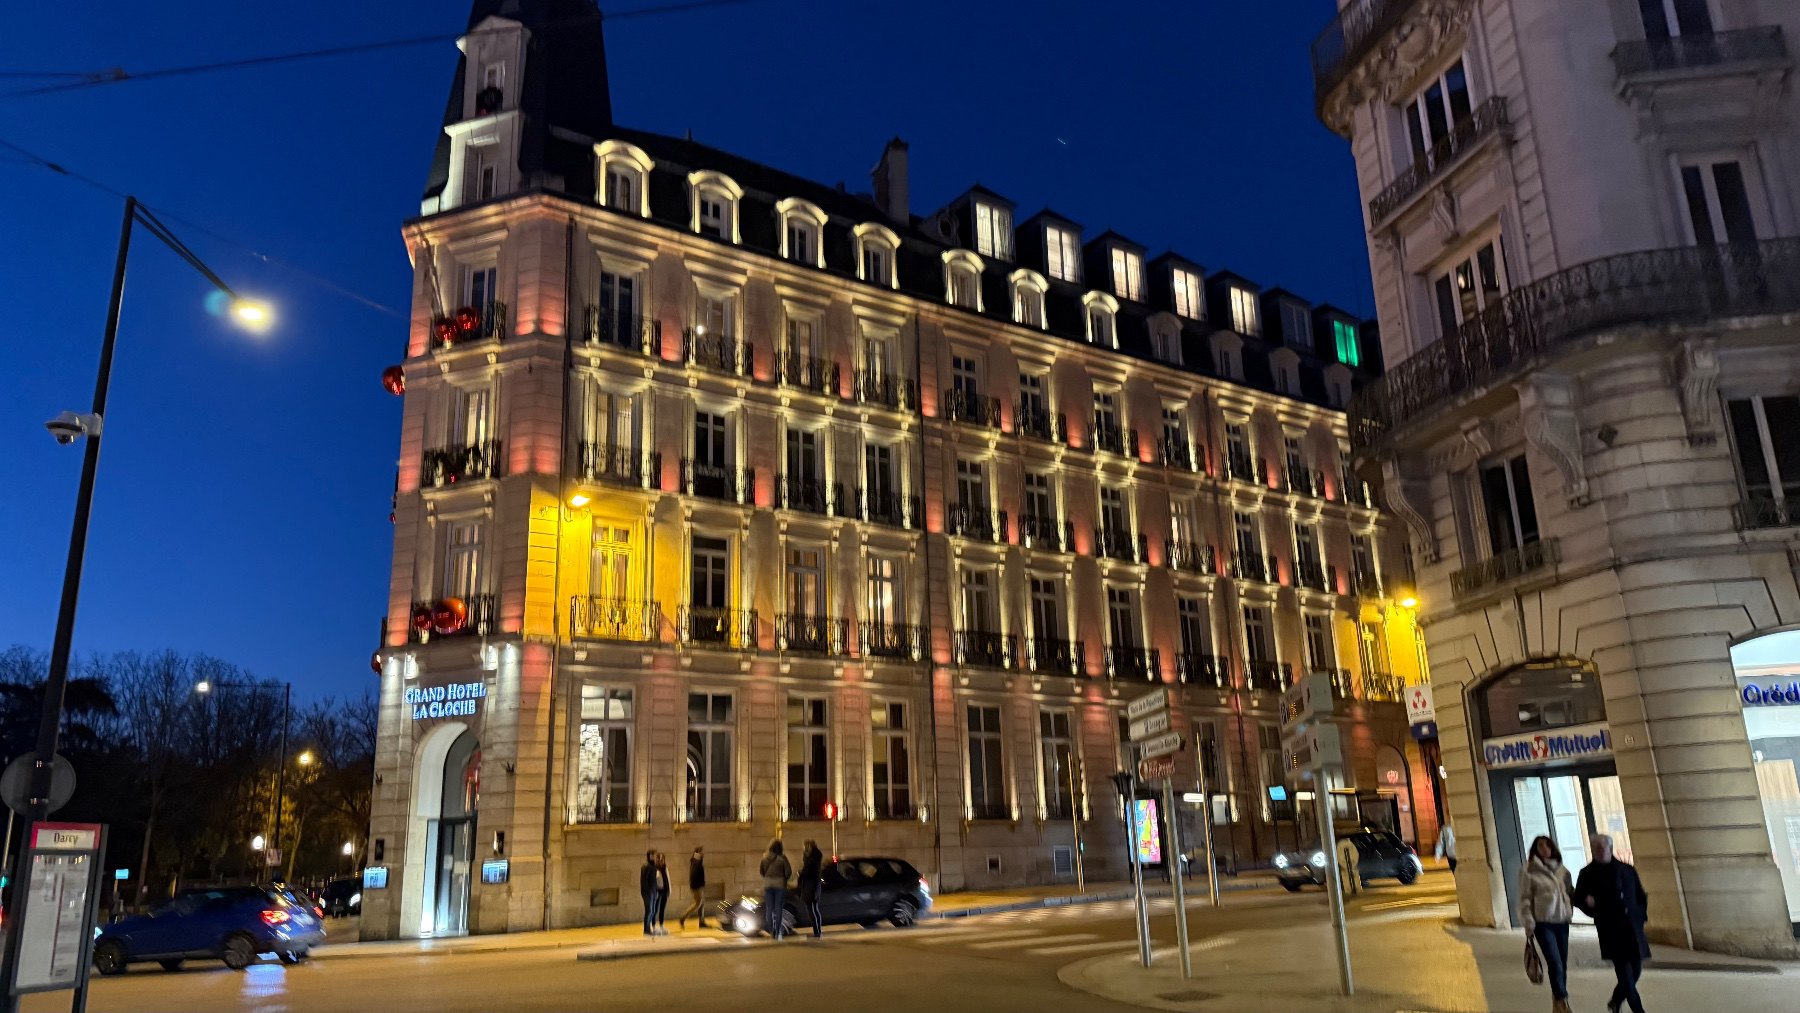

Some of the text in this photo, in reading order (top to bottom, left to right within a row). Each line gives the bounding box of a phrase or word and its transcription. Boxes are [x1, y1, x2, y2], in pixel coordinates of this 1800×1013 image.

[405, 683, 486, 704] GRAND HOTEL
[412, 704, 428, 720] LA
[1548, 729, 1606, 758] Mutuel
[54, 832, 79, 845] Darcy
